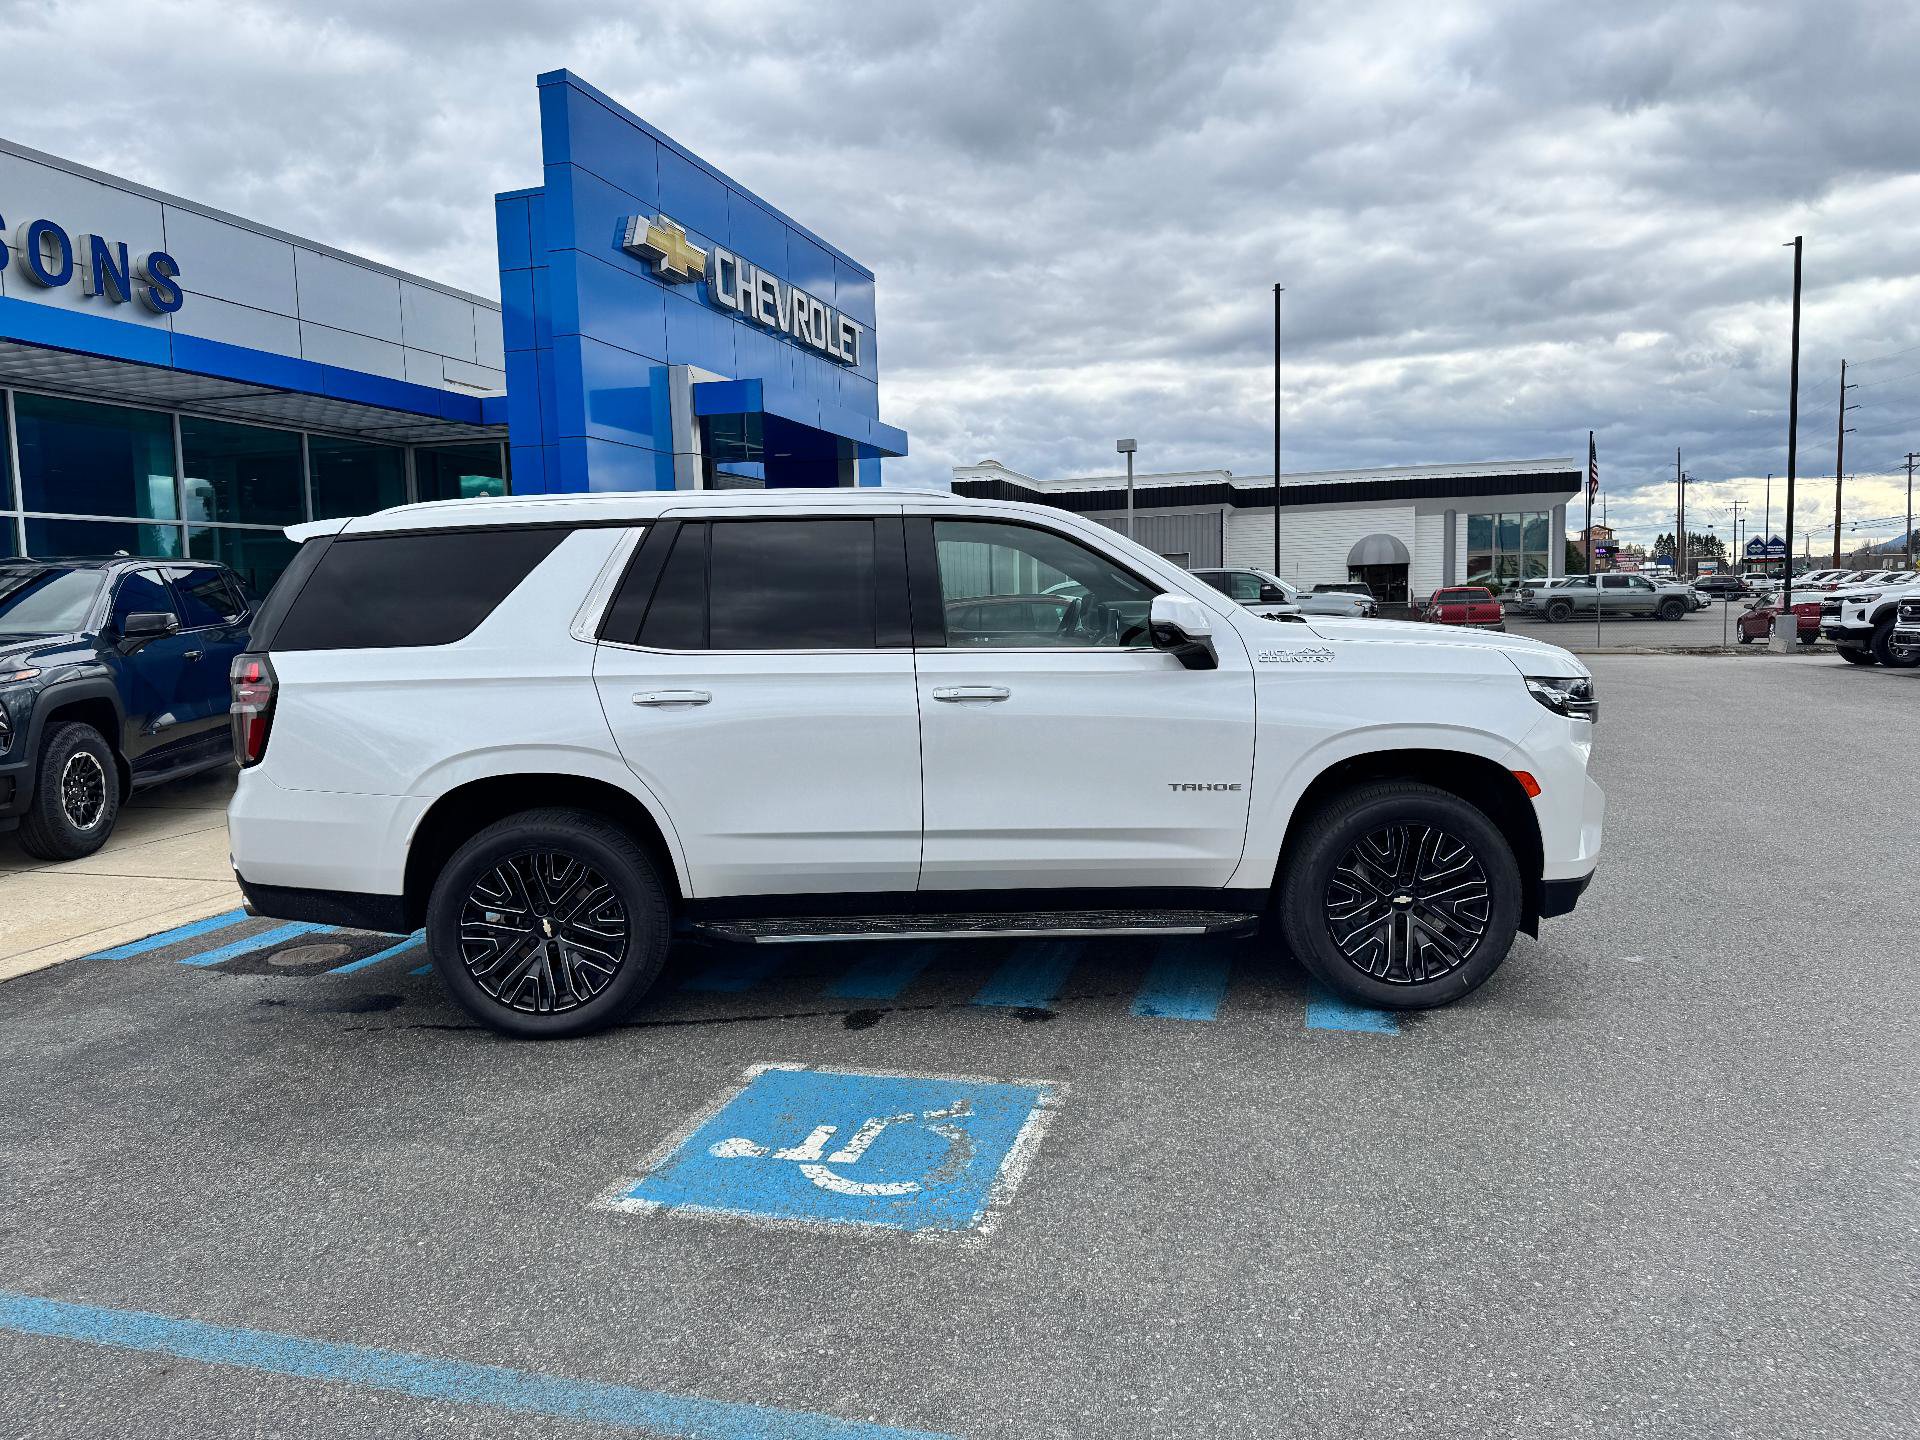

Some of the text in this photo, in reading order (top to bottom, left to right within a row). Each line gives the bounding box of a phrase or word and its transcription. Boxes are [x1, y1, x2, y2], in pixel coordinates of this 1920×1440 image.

[0, 213, 184, 313] ONS
[710, 246, 864, 367] CHEVROLET
[1167, 783, 1242, 792] TAHOE
